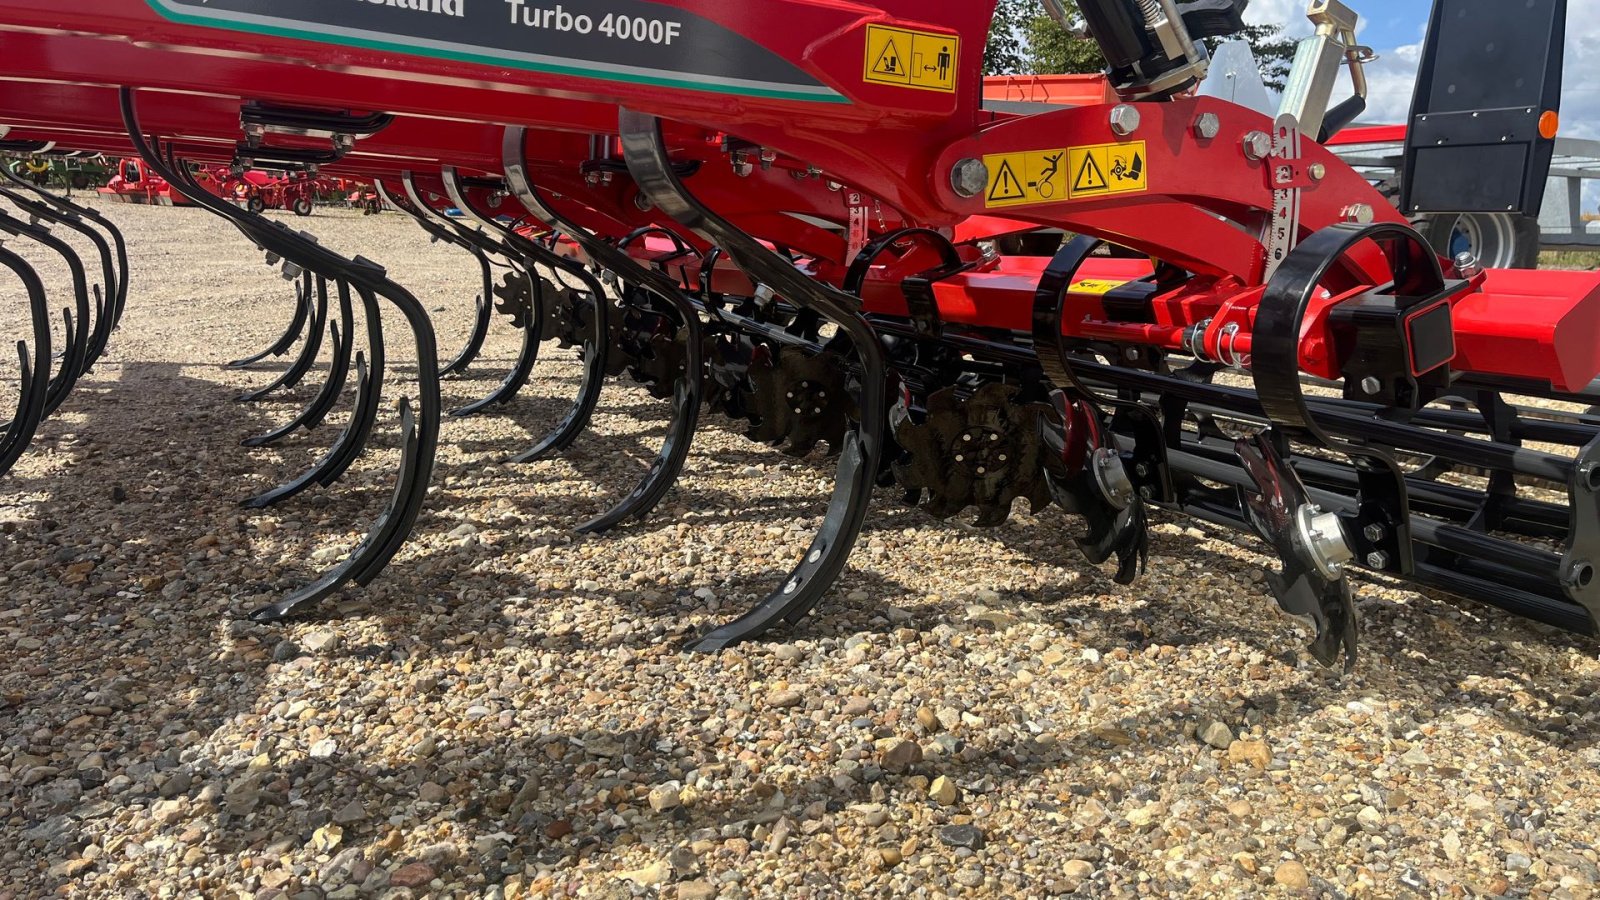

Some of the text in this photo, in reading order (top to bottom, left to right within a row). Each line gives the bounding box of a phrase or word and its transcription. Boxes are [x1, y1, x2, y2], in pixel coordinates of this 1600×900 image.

[505, 0, 681, 45] Turbo 4000F
[1281, 166, 1288, 179] 2
[853, 193, 859, 202] 2
[1280, 188, 1288, 200] 3
[1279, 206, 1287, 219] 4
[1277, 227, 1285, 240] 5
[1274, 247, 1282, 260] 6
